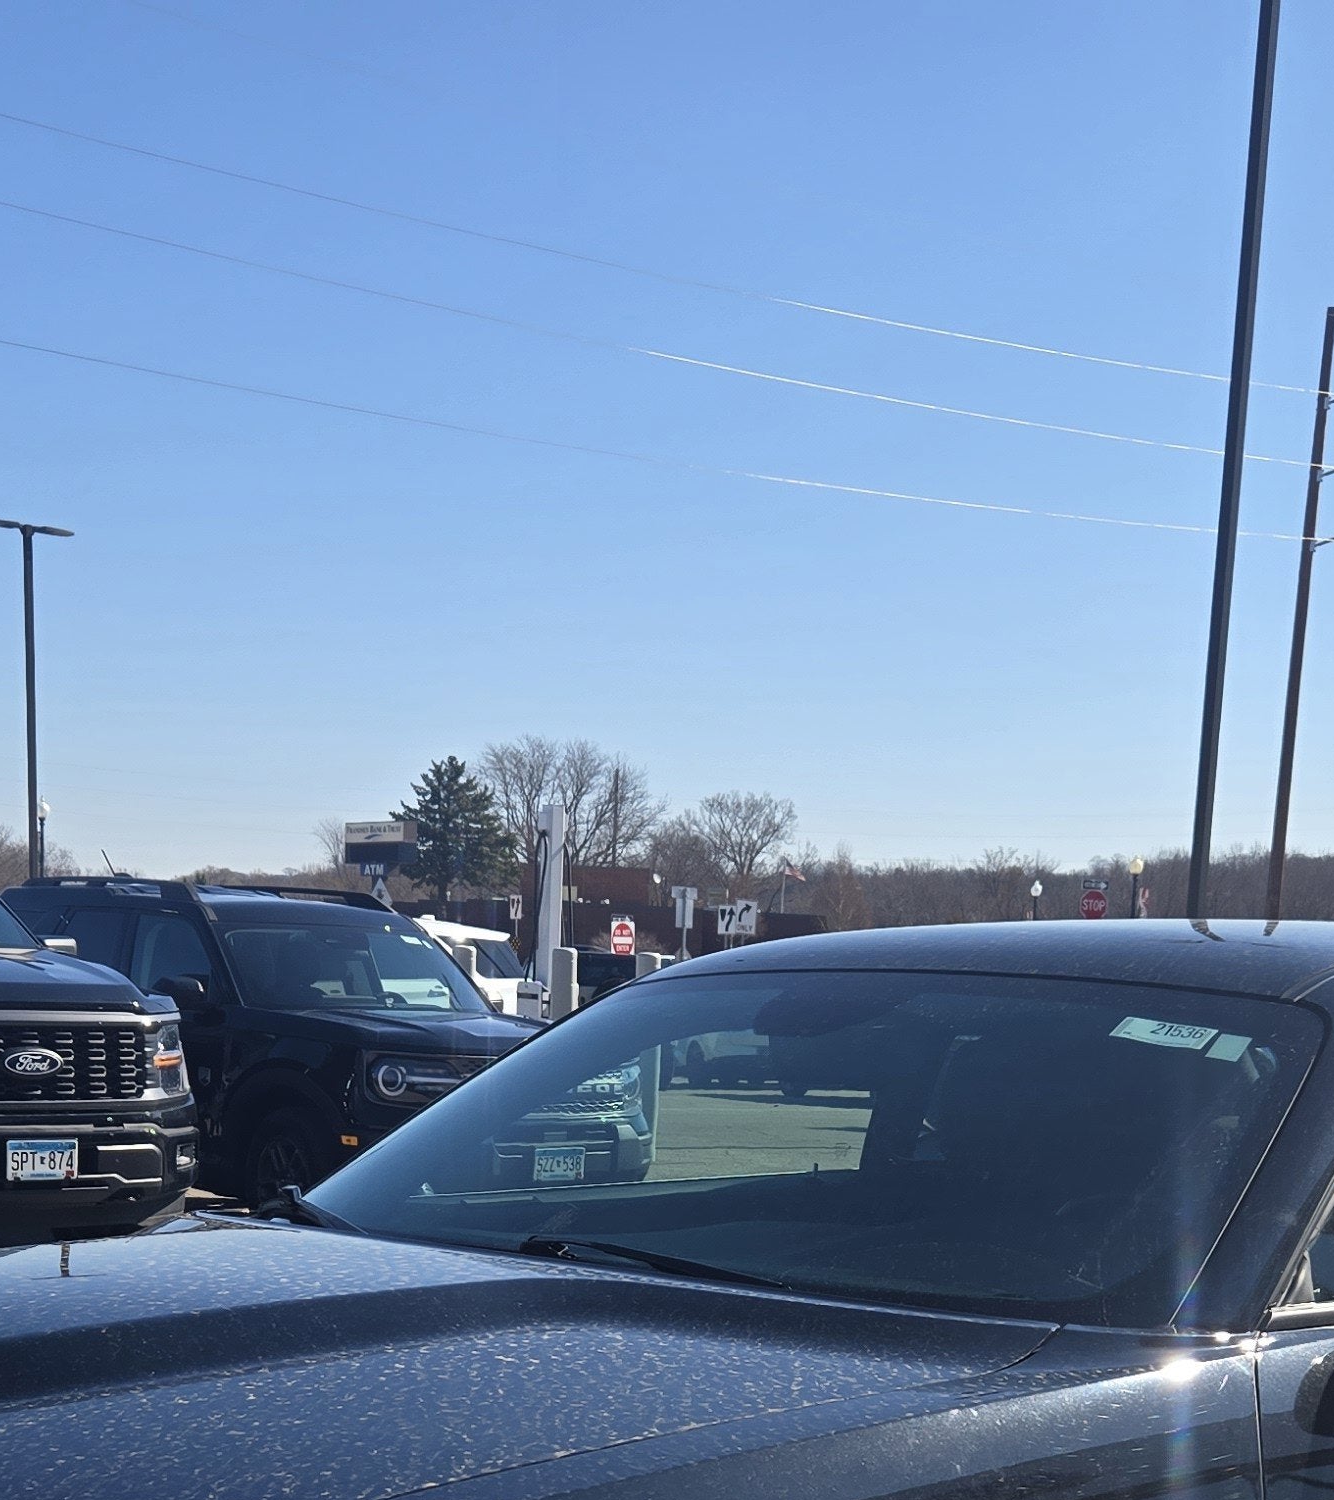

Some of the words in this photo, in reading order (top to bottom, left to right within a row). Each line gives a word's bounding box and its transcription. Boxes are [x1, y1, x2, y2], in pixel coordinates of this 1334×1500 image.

[364, 863, 384, 876] ATM
[1082, 899, 1106, 912] STOP
[1150, 1022, 1207, 1040] 21536
[15, 1053, 50, 1072] Ford
